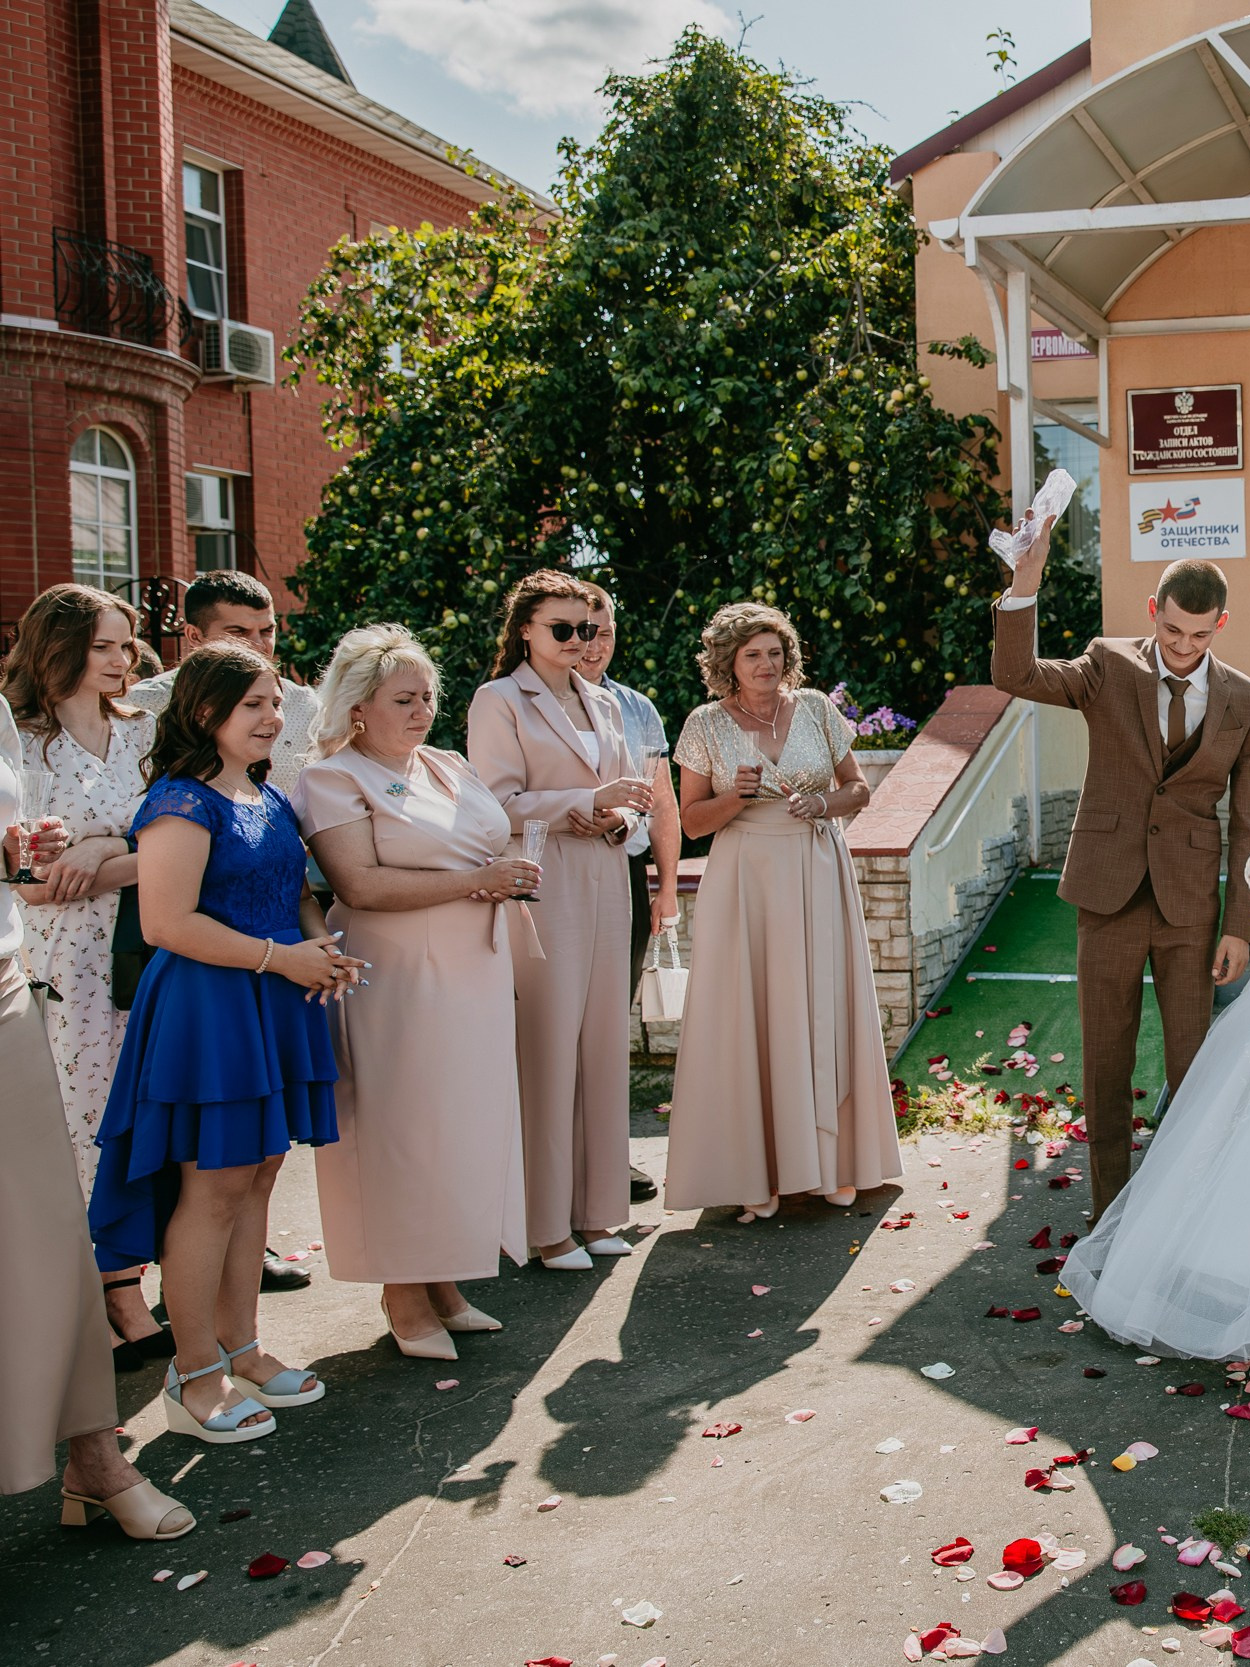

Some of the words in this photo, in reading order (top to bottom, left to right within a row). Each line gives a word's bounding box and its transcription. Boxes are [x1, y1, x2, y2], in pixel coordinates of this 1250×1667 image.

[1173, 425, 1198, 436] ОТДЕЛ
[1159, 438, 1188, 449] ЗАПИСИ
[1189, 436, 1214, 446] АКТОВ
[1193, 446, 1238, 458] СОСТОЯНИЯ
[1161, 525, 1239, 536] ЗАЩИТНИКИ
[1161, 537, 1230, 547] ОТЕЧЕСТВА
